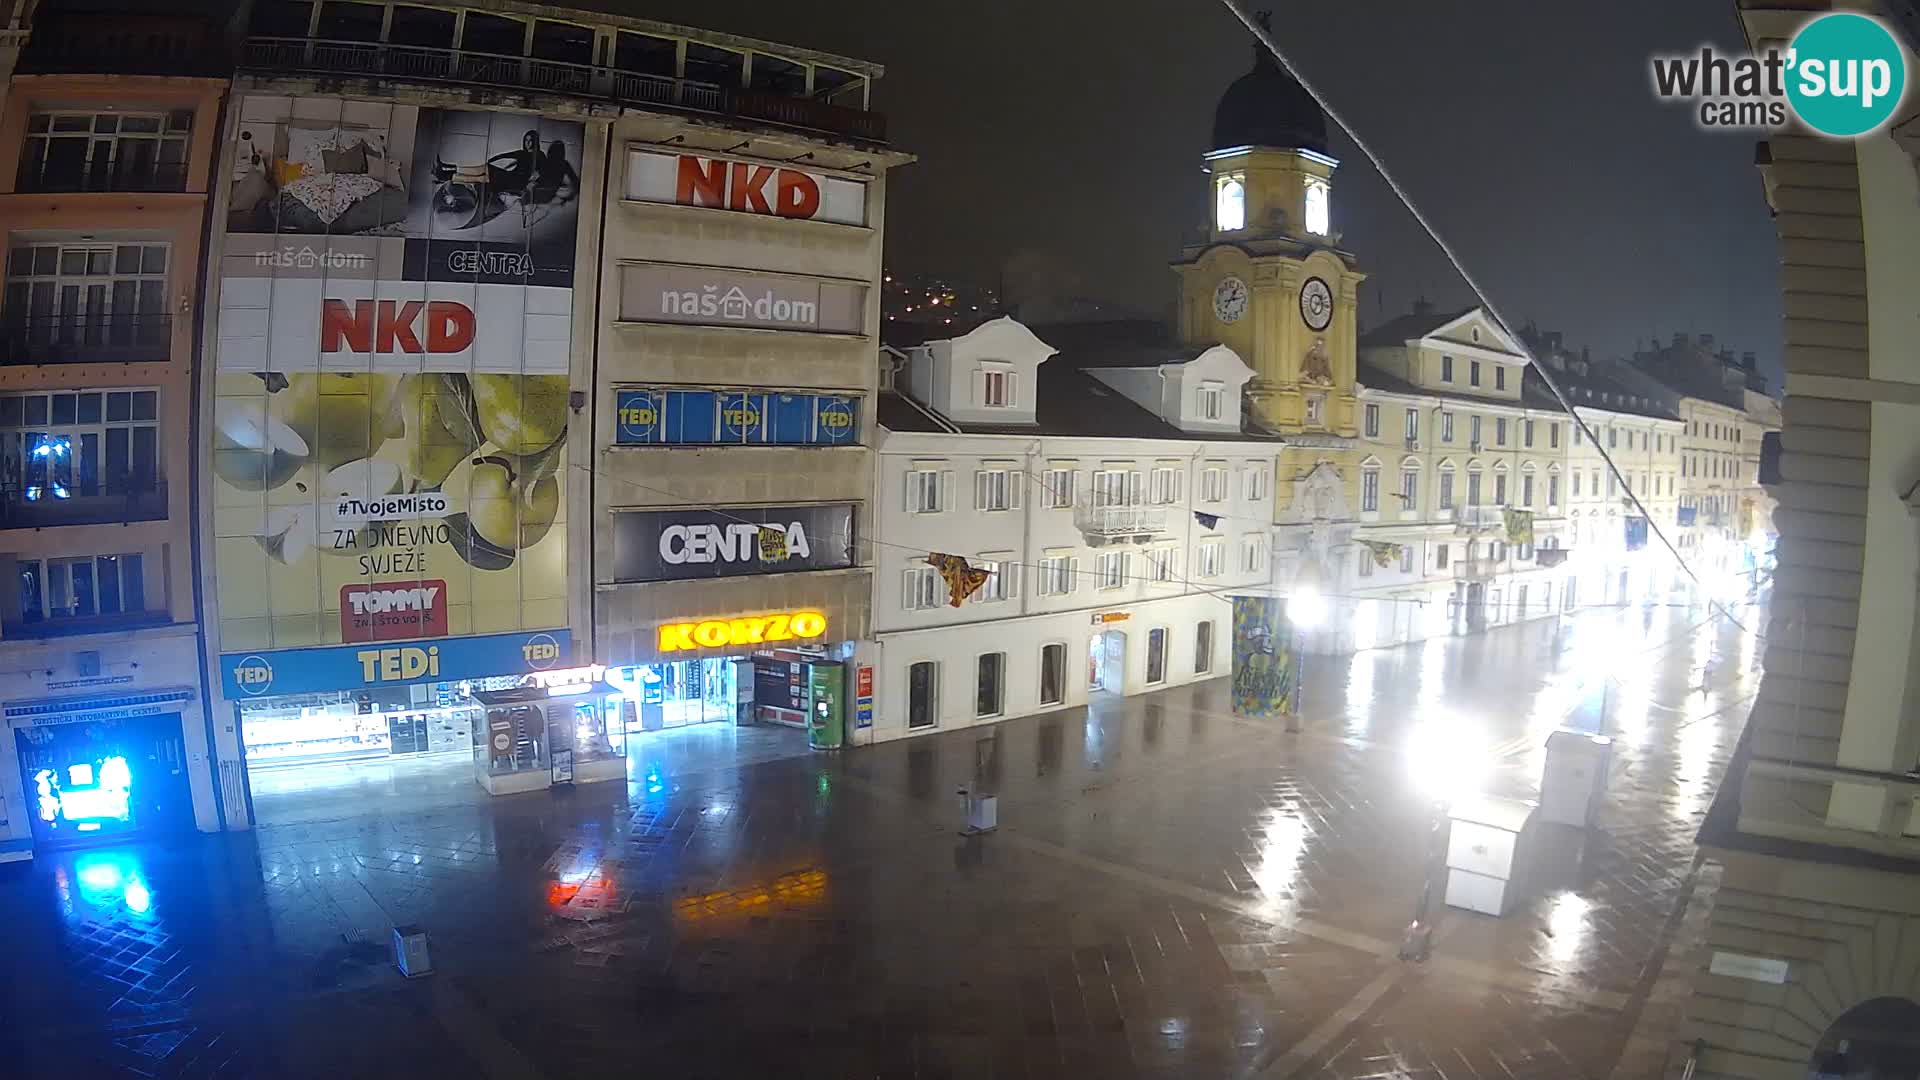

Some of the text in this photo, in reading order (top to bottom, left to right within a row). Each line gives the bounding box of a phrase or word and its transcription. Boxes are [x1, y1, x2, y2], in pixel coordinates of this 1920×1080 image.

[675, 154, 820, 219] NKD
[255, 247, 366, 269] naš dom
[447, 250, 535, 276] CENTRA
[661, 284, 817, 324] naš dom
[320, 298, 477, 354] NKD
[618, 408, 658, 425] TEDi
[723, 409, 760, 426] TEDi
[337, 498, 446, 517] #TvojeMisto
[334, 524, 450, 550] ZA DNEVNO
[359, 548, 426, 576] SVJEŽE
[348, 586, 439, 615] TOMMY
[352, 618, 376, 629] ZN
[657, 611, 827, 653] KORZO
[357, 646, 441, 683] TEDi
[521, 643, 561, 661] TEDi
[233, 666, 274, 684] TEDi
